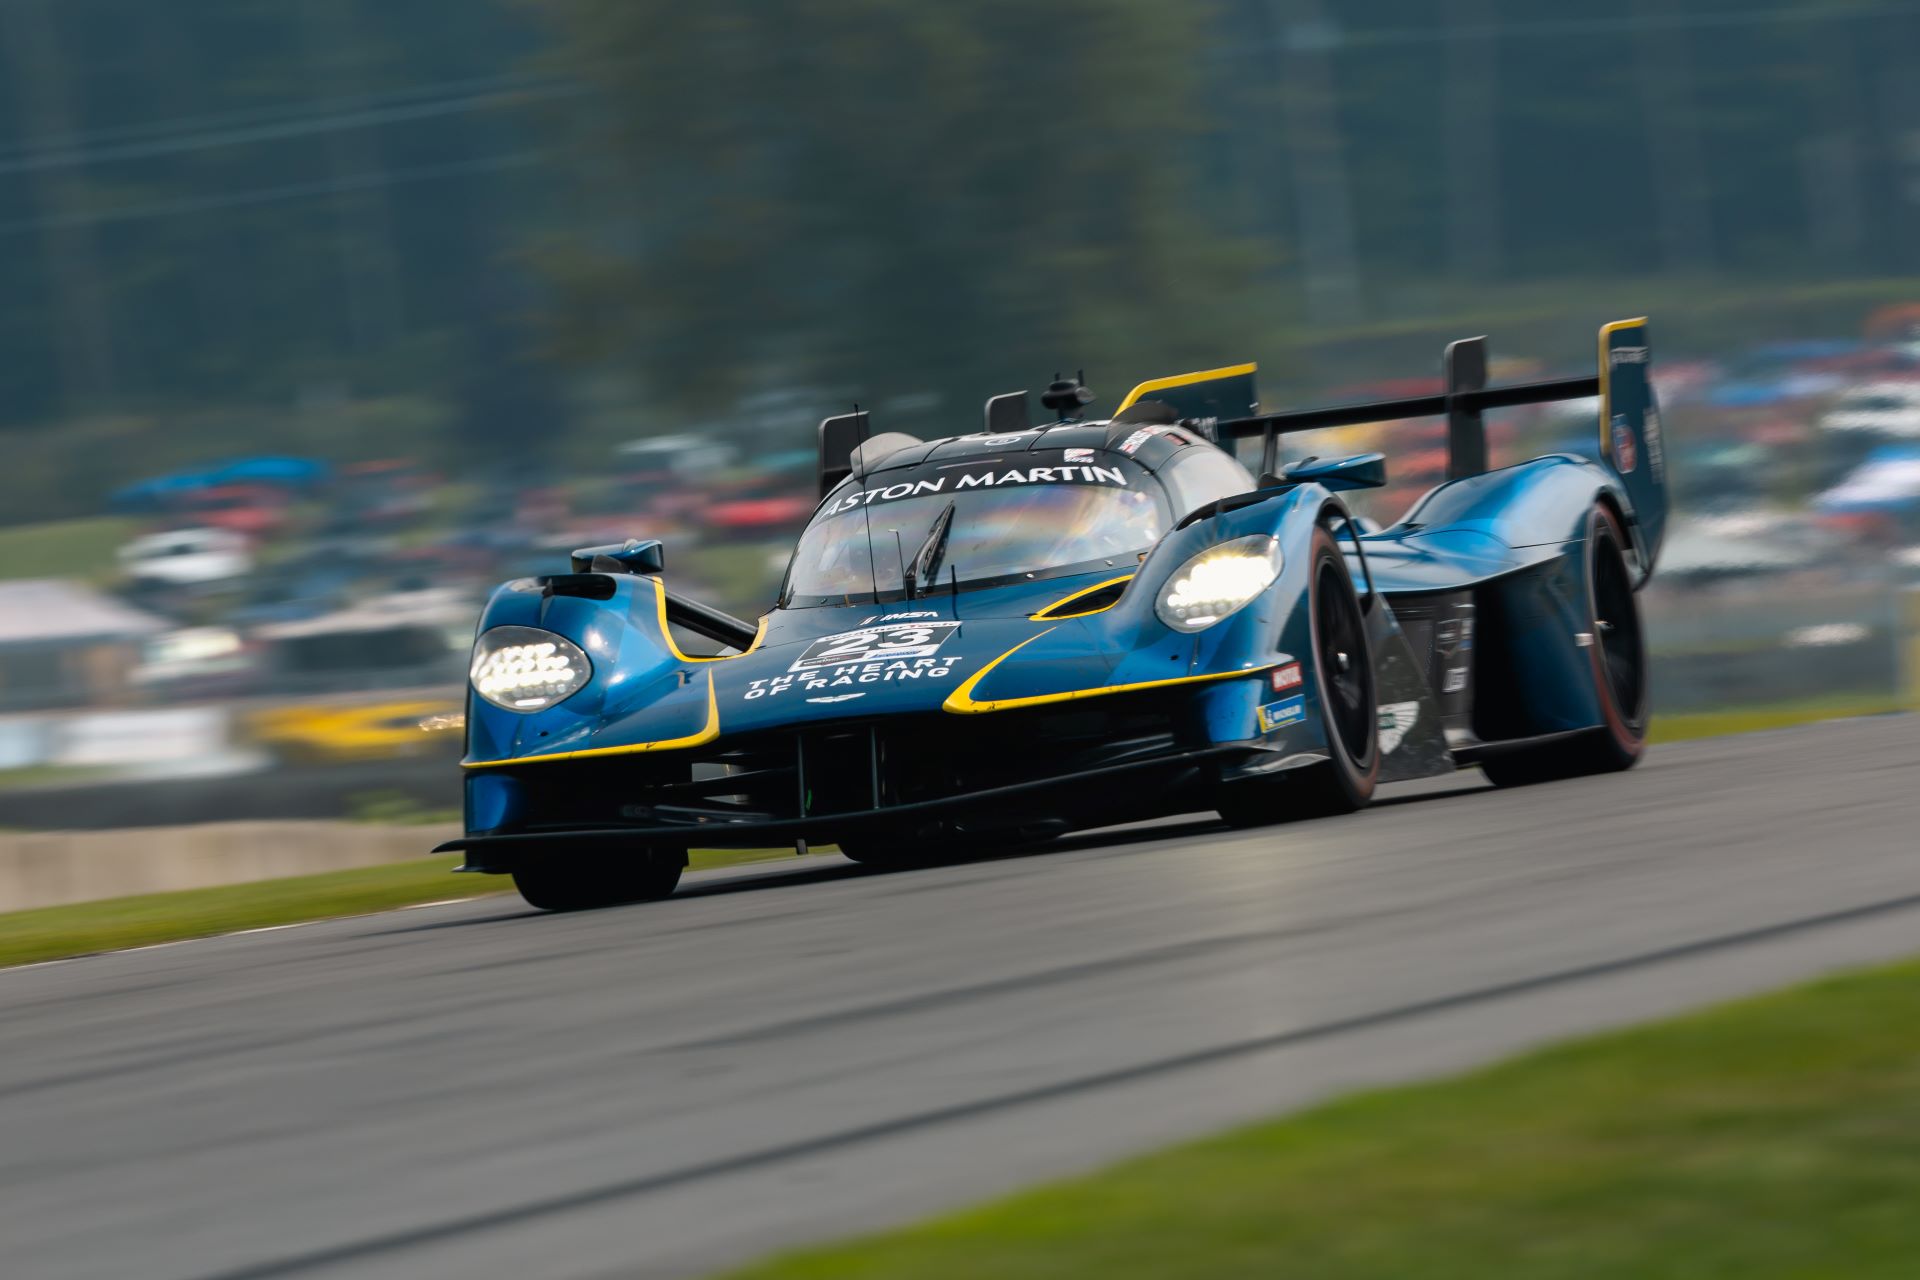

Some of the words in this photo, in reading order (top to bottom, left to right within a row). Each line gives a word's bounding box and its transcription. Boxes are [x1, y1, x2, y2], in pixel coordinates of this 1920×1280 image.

[820, 477, 946, 519] ASTON
[955, 465, 1128, 489] MARTIN
[817, 628, 934, 658] 23
[743, 683, 792, 700] OF
[805, 667, 950, 690] RACING
[749, 670, 820, 690] THE
[834, 656, 963, 676] HEART
